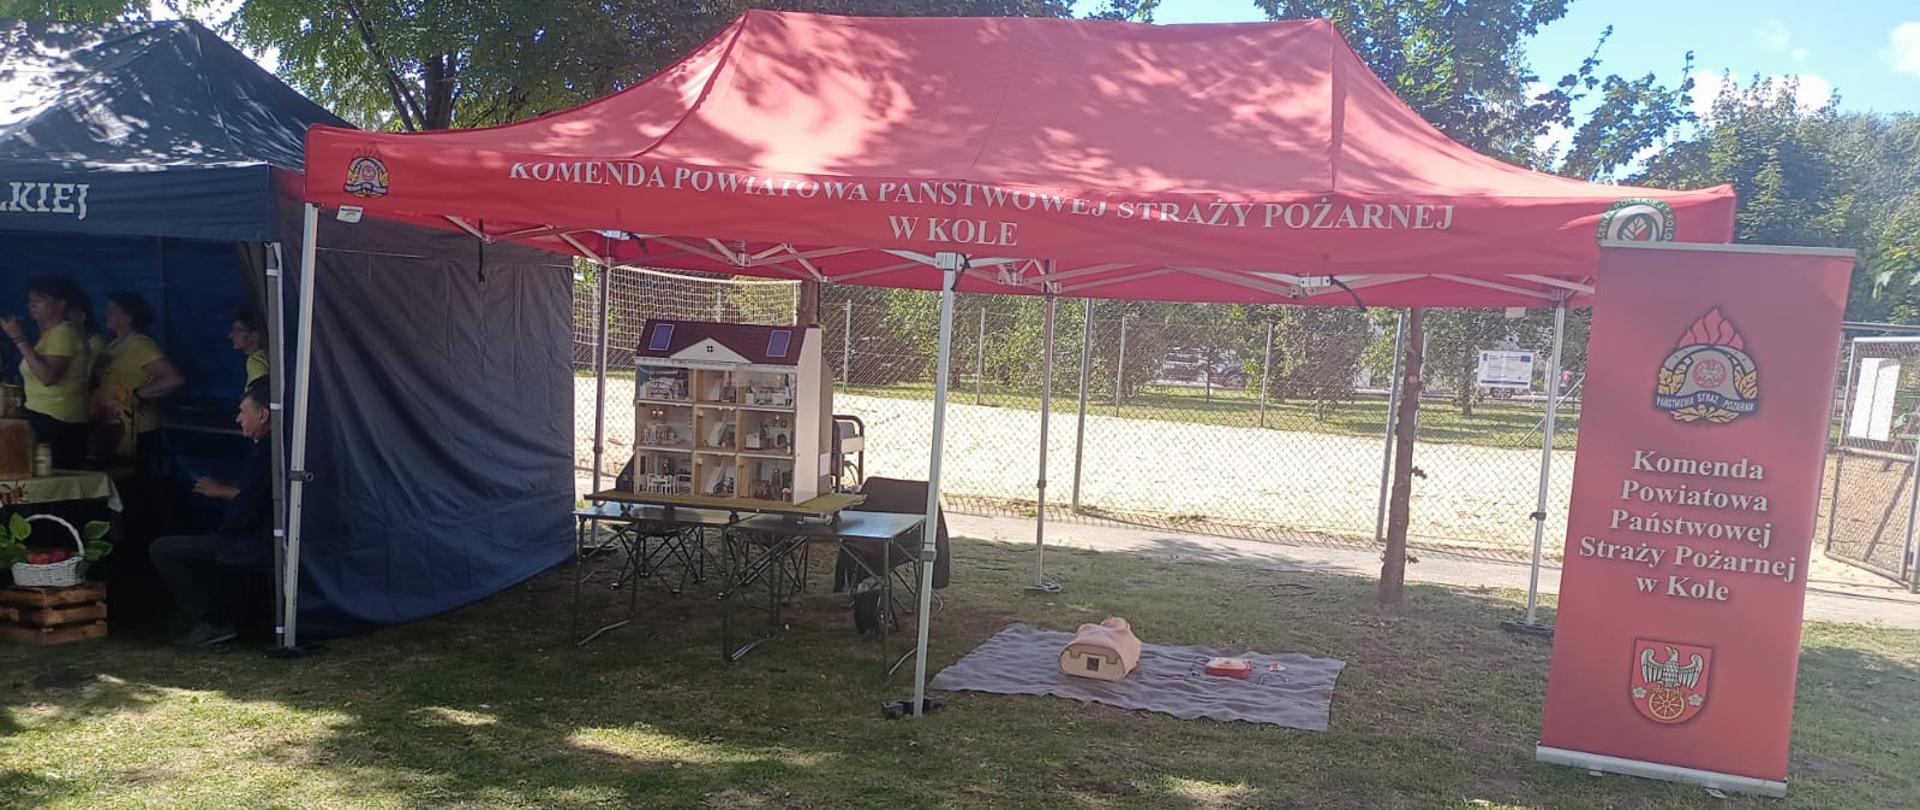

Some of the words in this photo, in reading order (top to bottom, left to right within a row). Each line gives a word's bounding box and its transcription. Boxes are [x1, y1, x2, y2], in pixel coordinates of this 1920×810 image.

[509, 161, 665, 189] KOMENDA
[673, 167, 870, 202] POWIATOWA
[1116, 198, 1255, 228] STRAŻY
[1263, 196, 1457, 230] POŻARNEJ
[888, 214, 919, 241] W
[927, 217, 1019, 247] KOLE
[1633, 449, 1764, 480] Komenda
[1621, 480, 1769, 512] Powiatowa
[1609, 509, 1772, 548] Państwowej
[1579, 536, 1666, 567] Straży
[1674, 545, 1796, 582] Pożarnej
[1635, 576, 1658, 594] w
[1666, 574, 1730, 602] Kole
